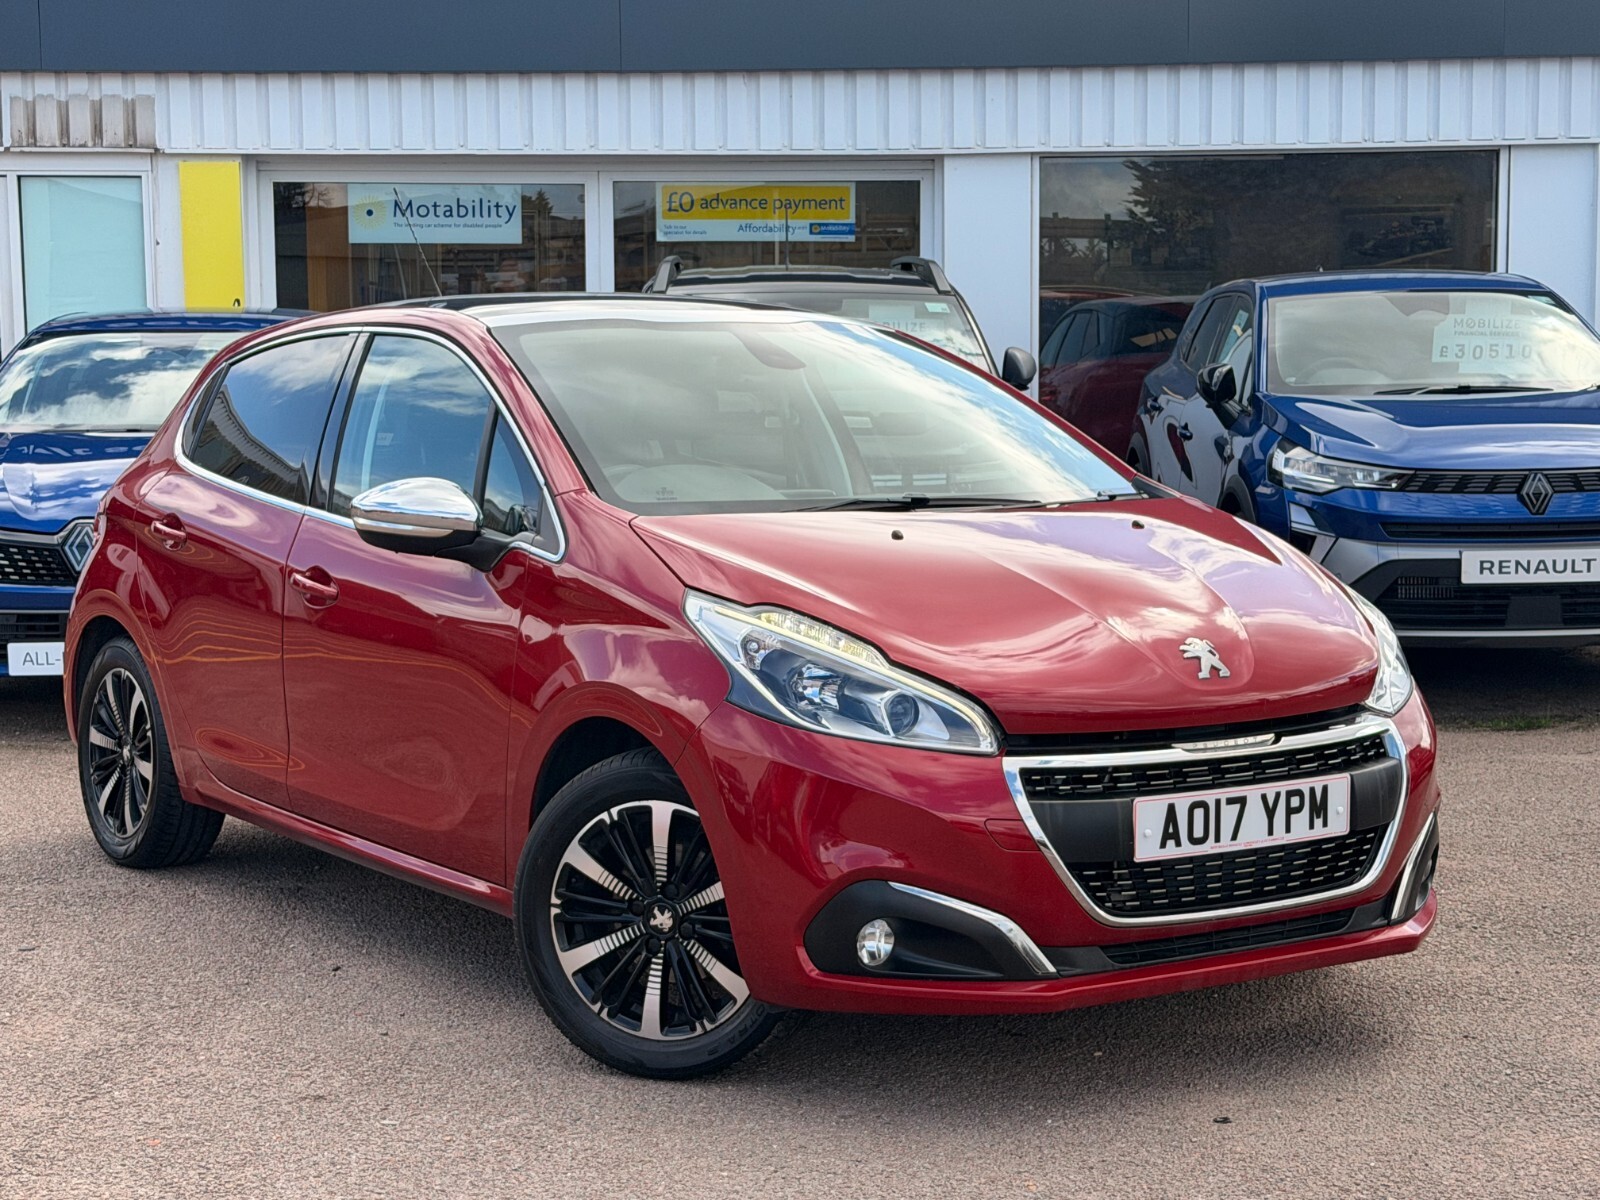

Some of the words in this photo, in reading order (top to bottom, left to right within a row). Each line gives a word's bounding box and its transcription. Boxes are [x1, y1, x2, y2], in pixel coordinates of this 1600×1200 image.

[393, 198, 517, 224] Motability
[666, 191, 695, 213] £0
[700, 193, 769, 211] advance
[773, 197, 846, 215] payment
[737, 223, 797, 235] Affordabilty
[1479, 558, 1597, 575] RENAULT
[1159, 795, 1248, 849] AO17
[1260, 784, 1329, 837] YPM
